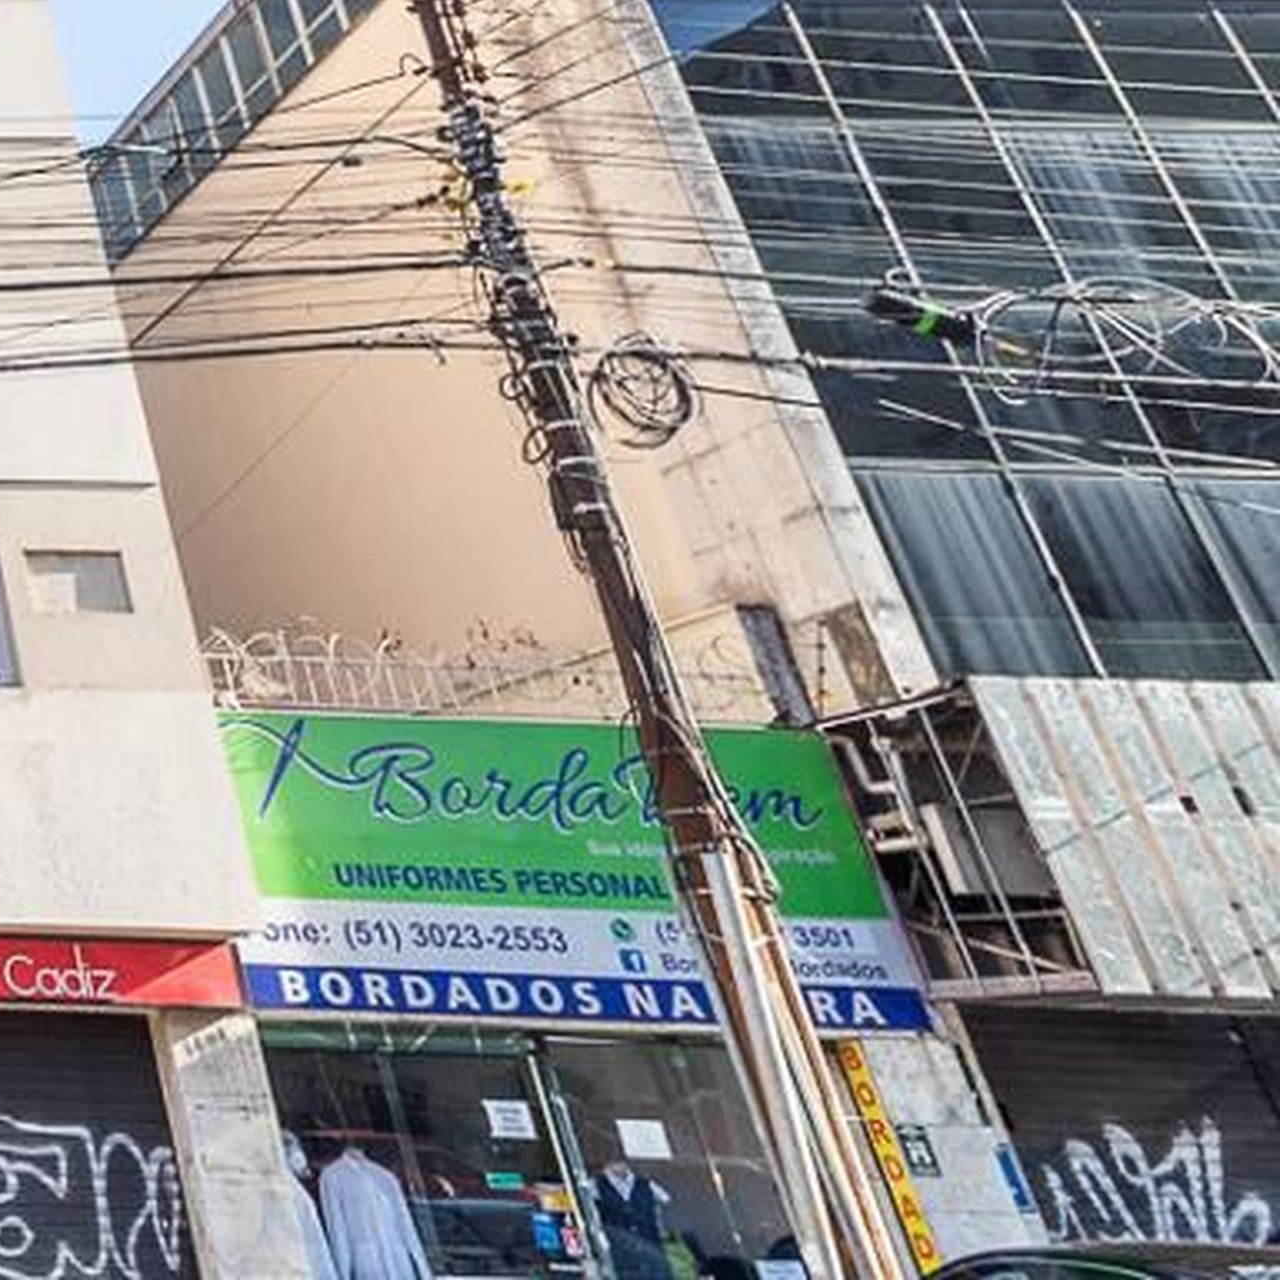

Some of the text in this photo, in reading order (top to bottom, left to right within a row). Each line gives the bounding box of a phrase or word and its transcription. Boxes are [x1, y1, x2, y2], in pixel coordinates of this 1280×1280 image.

[332, 863, 669, 900] UNIFORMES PERSONAL
[264, 920, 568, 953] one: (51) 3023-2553
[3, 943, 118, 998] Cadiz
[279, 969, 889, 1025] BORDADOS NA RA
[841, 1045, 935, 1260] BORDAD
